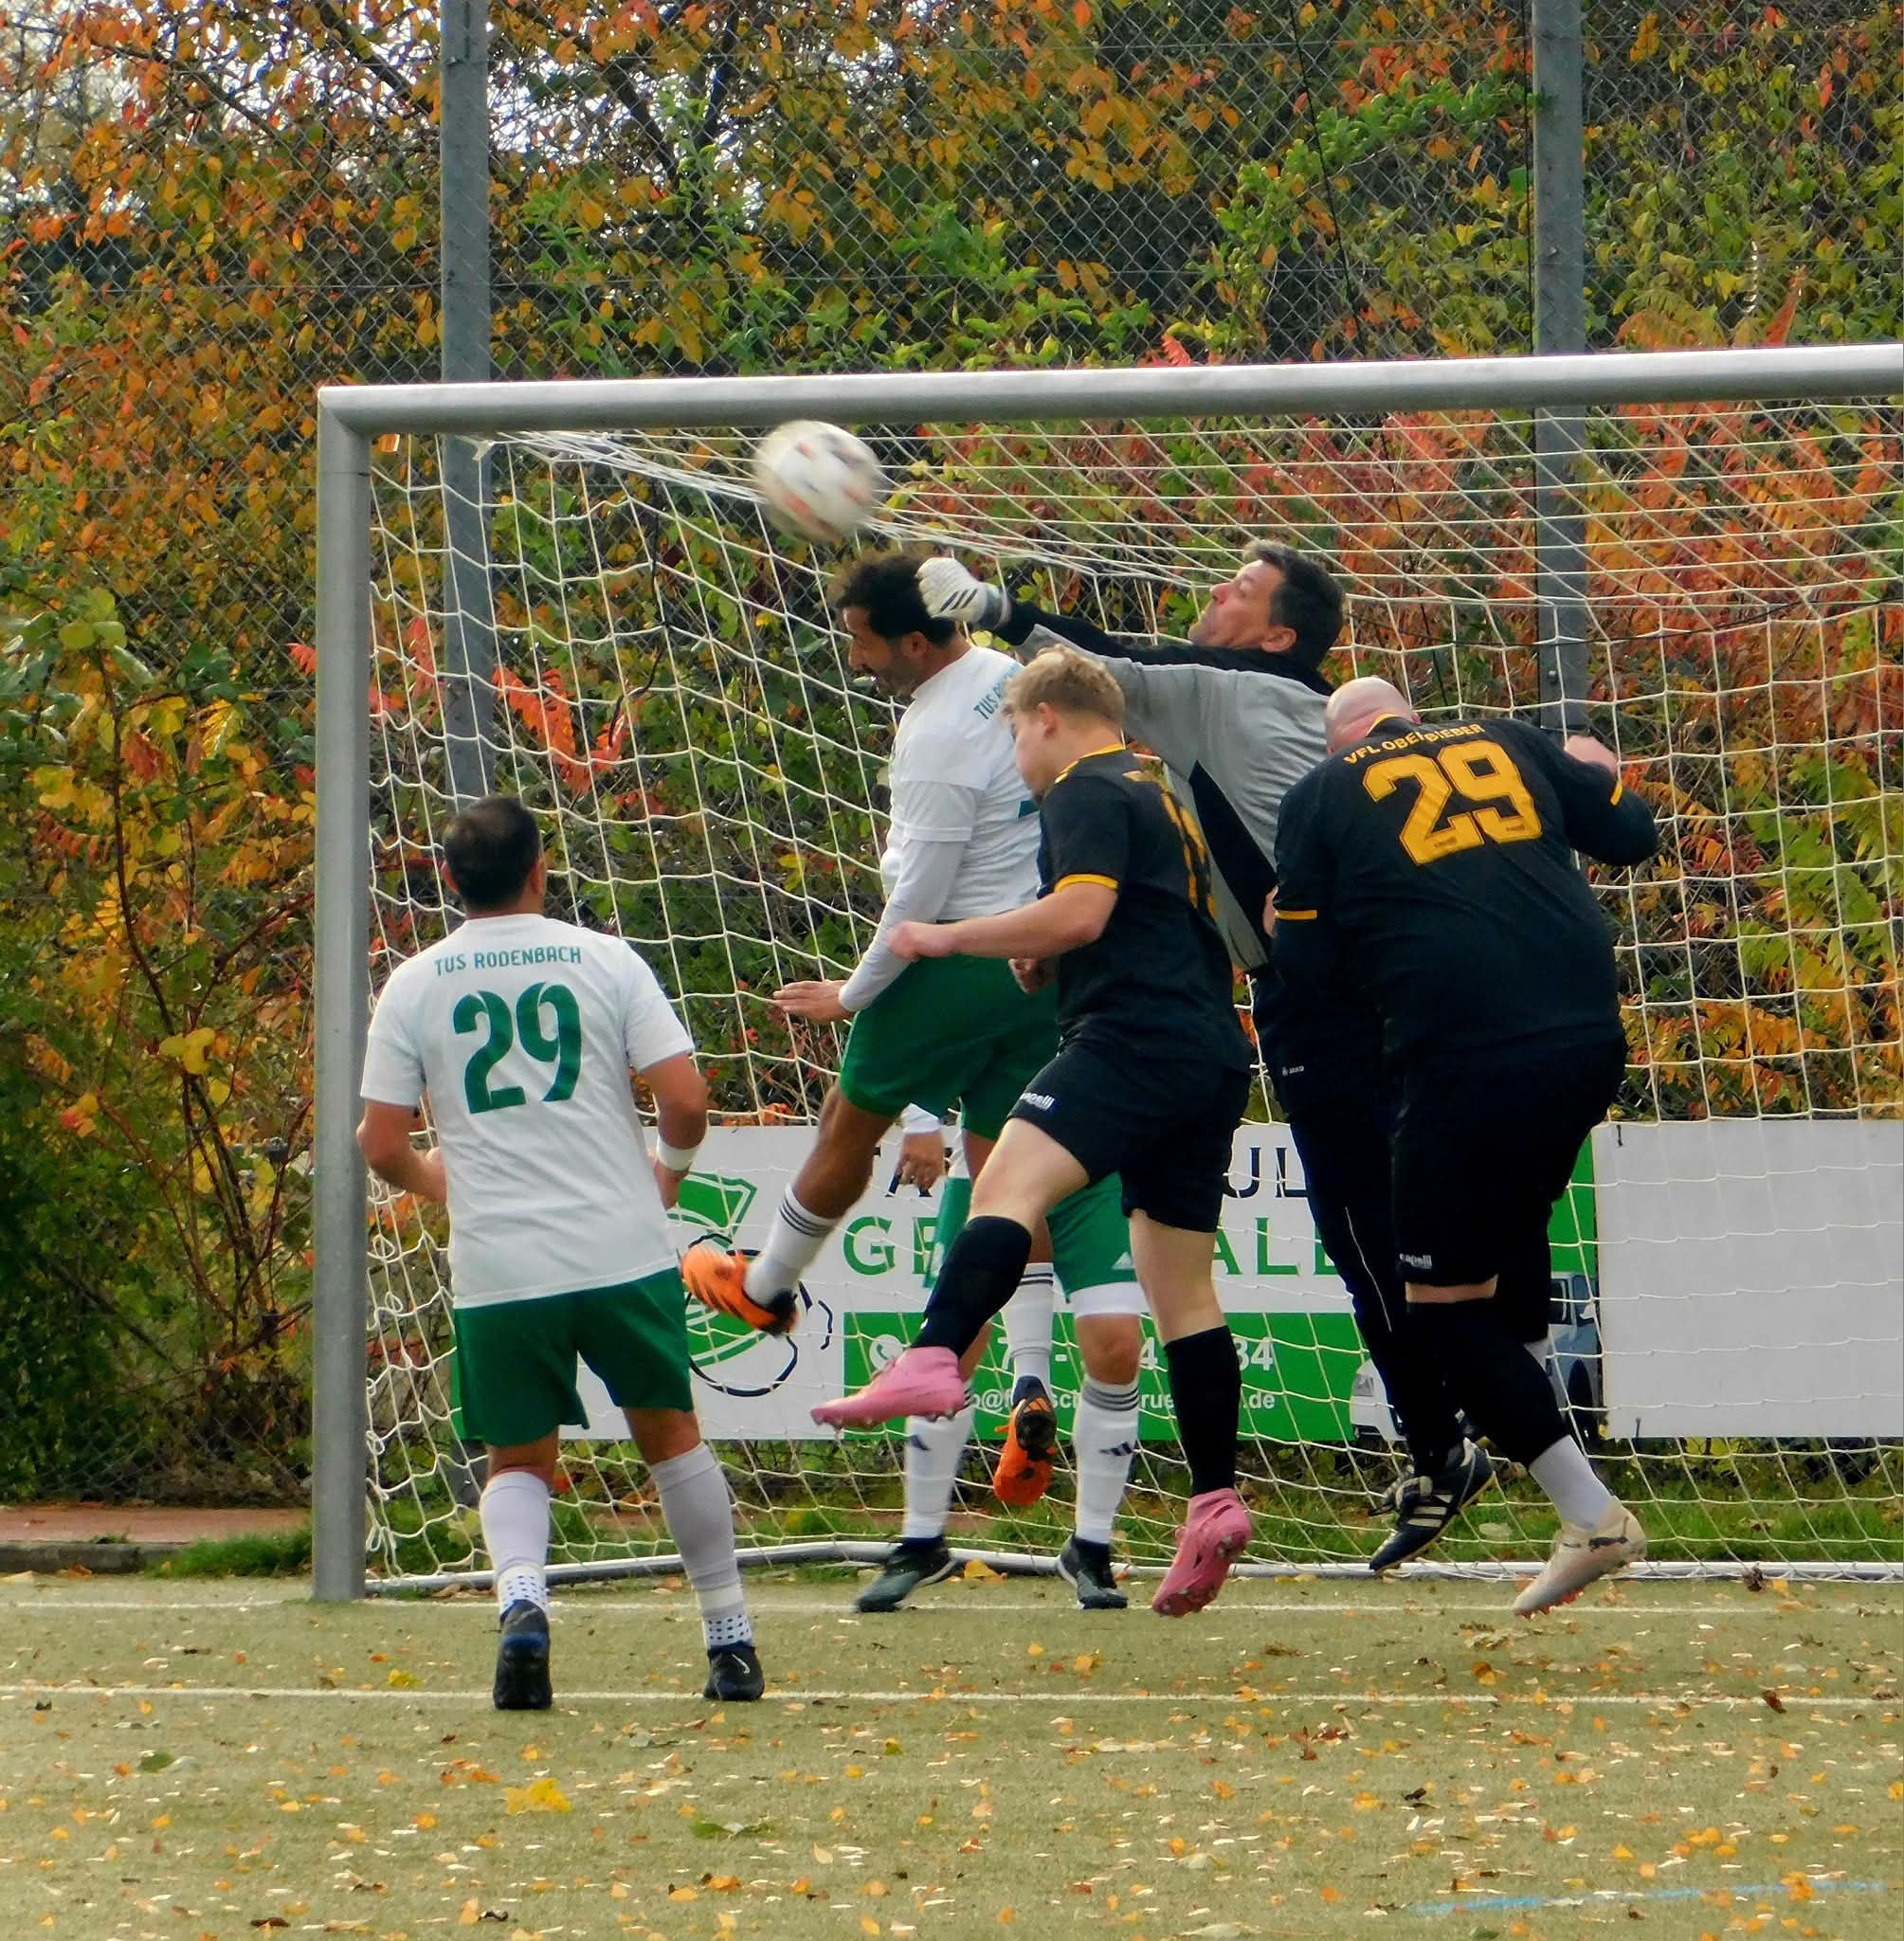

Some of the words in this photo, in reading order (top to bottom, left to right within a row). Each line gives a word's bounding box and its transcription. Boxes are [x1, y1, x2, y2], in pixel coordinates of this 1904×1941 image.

[1343, 745, 1381, 765] VFL
[1362, 739, 1543, 866] 29
[434, 953, 466, 976] TUS
[474, 946, 582, 969] RODENBACH
[452, 981, 582, 1115] 29
